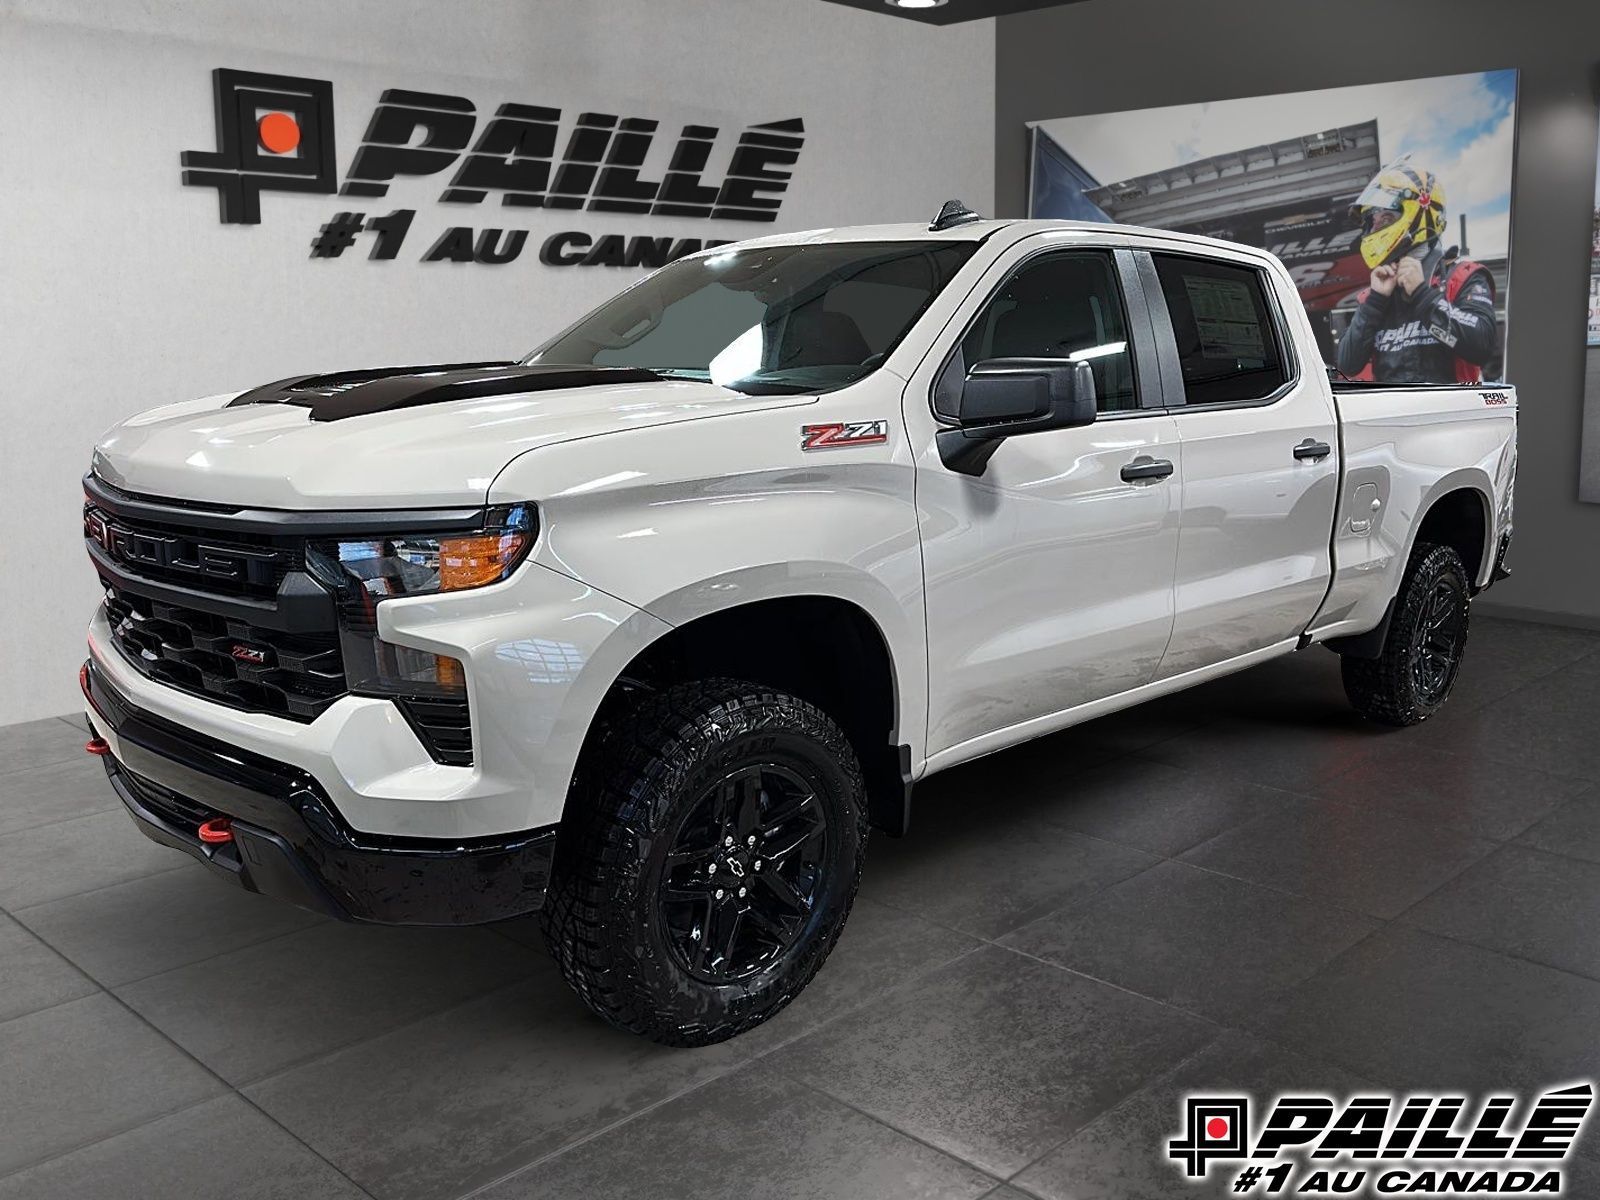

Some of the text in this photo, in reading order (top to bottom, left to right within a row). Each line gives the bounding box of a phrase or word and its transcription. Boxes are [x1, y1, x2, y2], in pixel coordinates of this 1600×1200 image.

[338, 88, 805, 222] PAILLÉ
[309, 208, 416, 261] #1
[420, 226, 528, 264] AU
[801, 420, 887, 451] Z71
